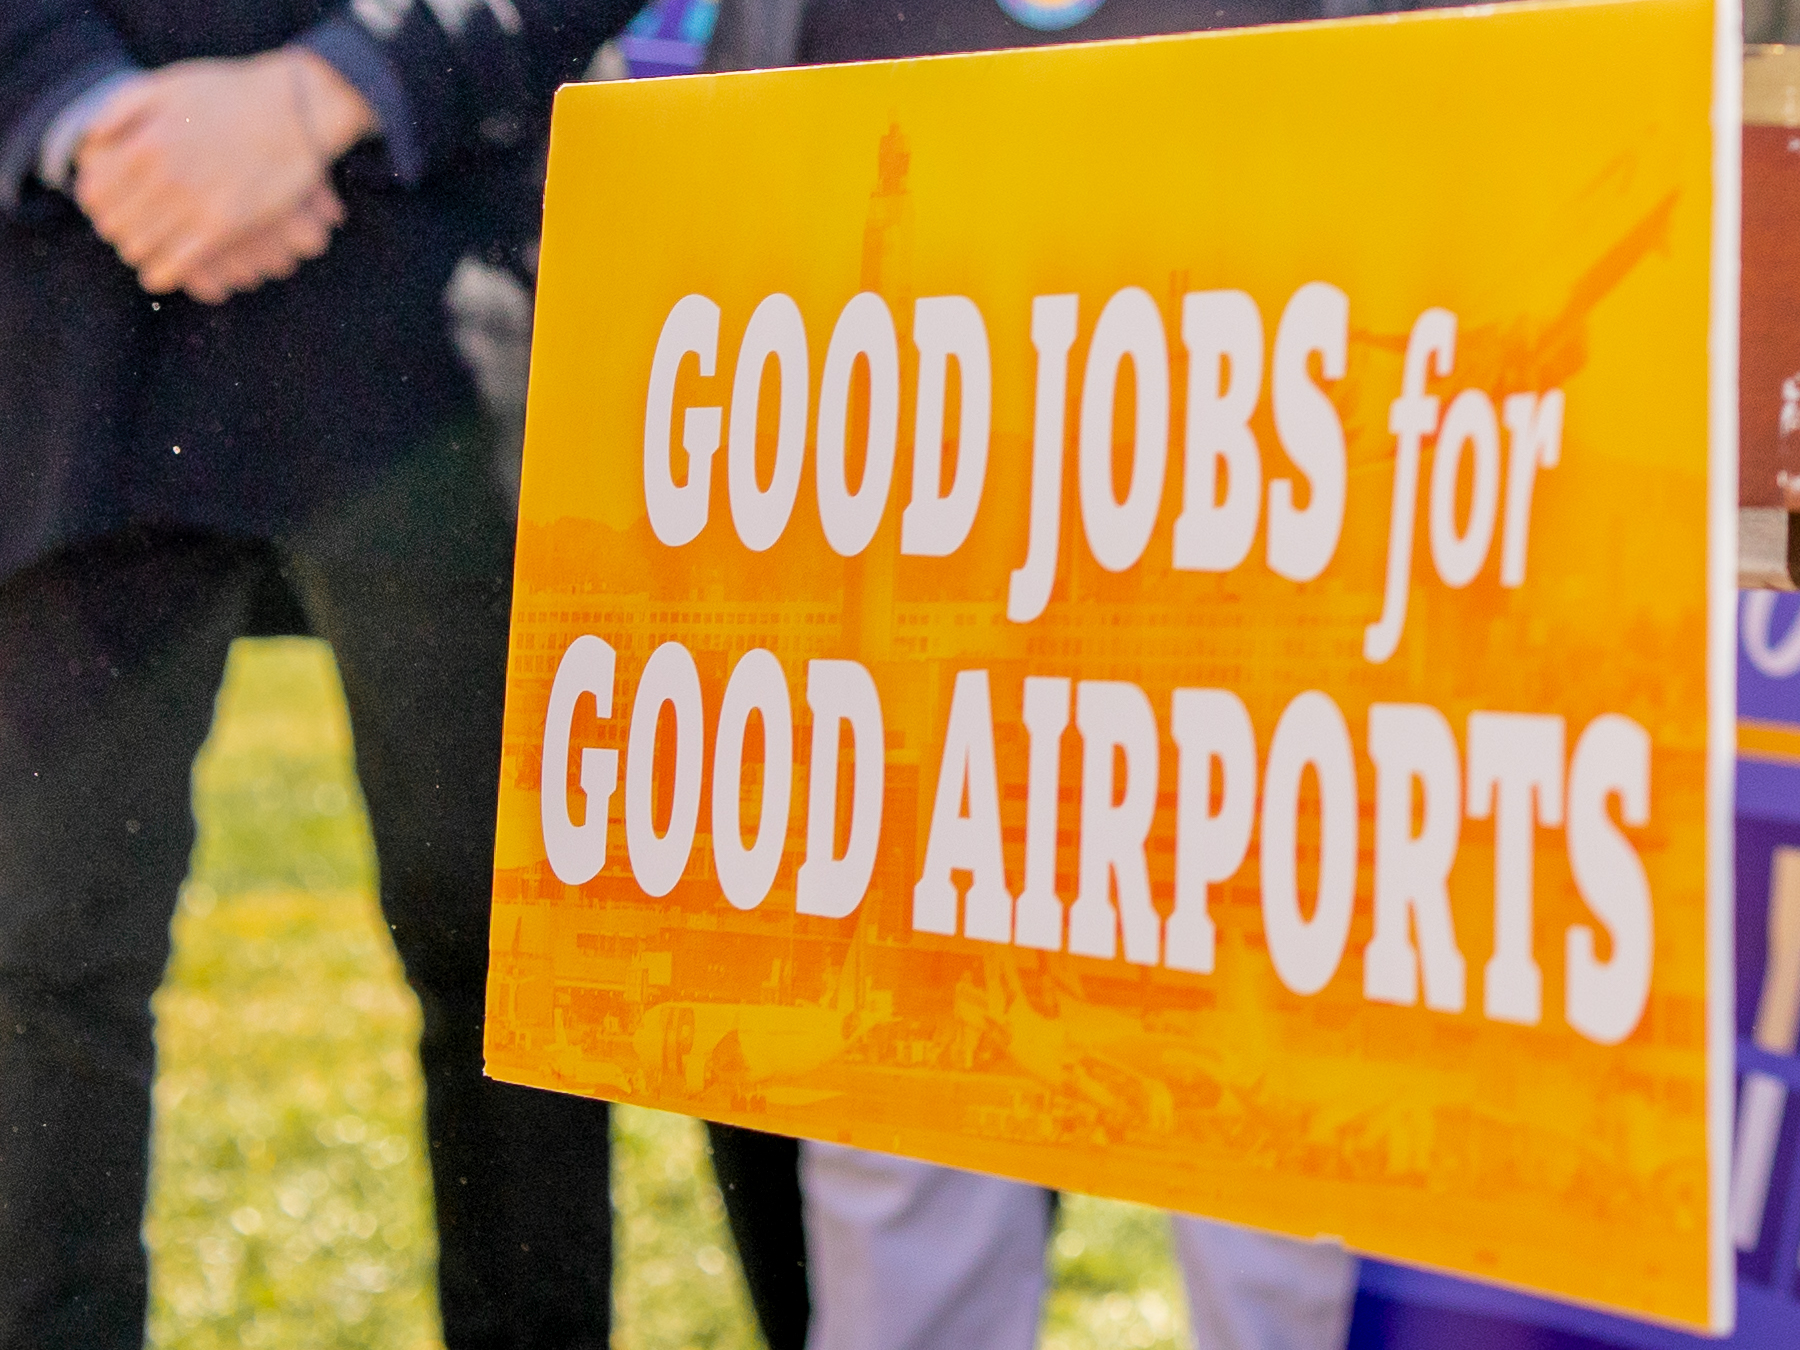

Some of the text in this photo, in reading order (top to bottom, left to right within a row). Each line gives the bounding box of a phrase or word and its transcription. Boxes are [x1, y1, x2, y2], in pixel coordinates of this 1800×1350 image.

[644, 291, 992, 556] GOOD
[1006, 281, 1350, 623] JOBS
[1362, 308, 1564, 663] for
[540, 634, 1656, 1044] GOOD AIRPORTS
